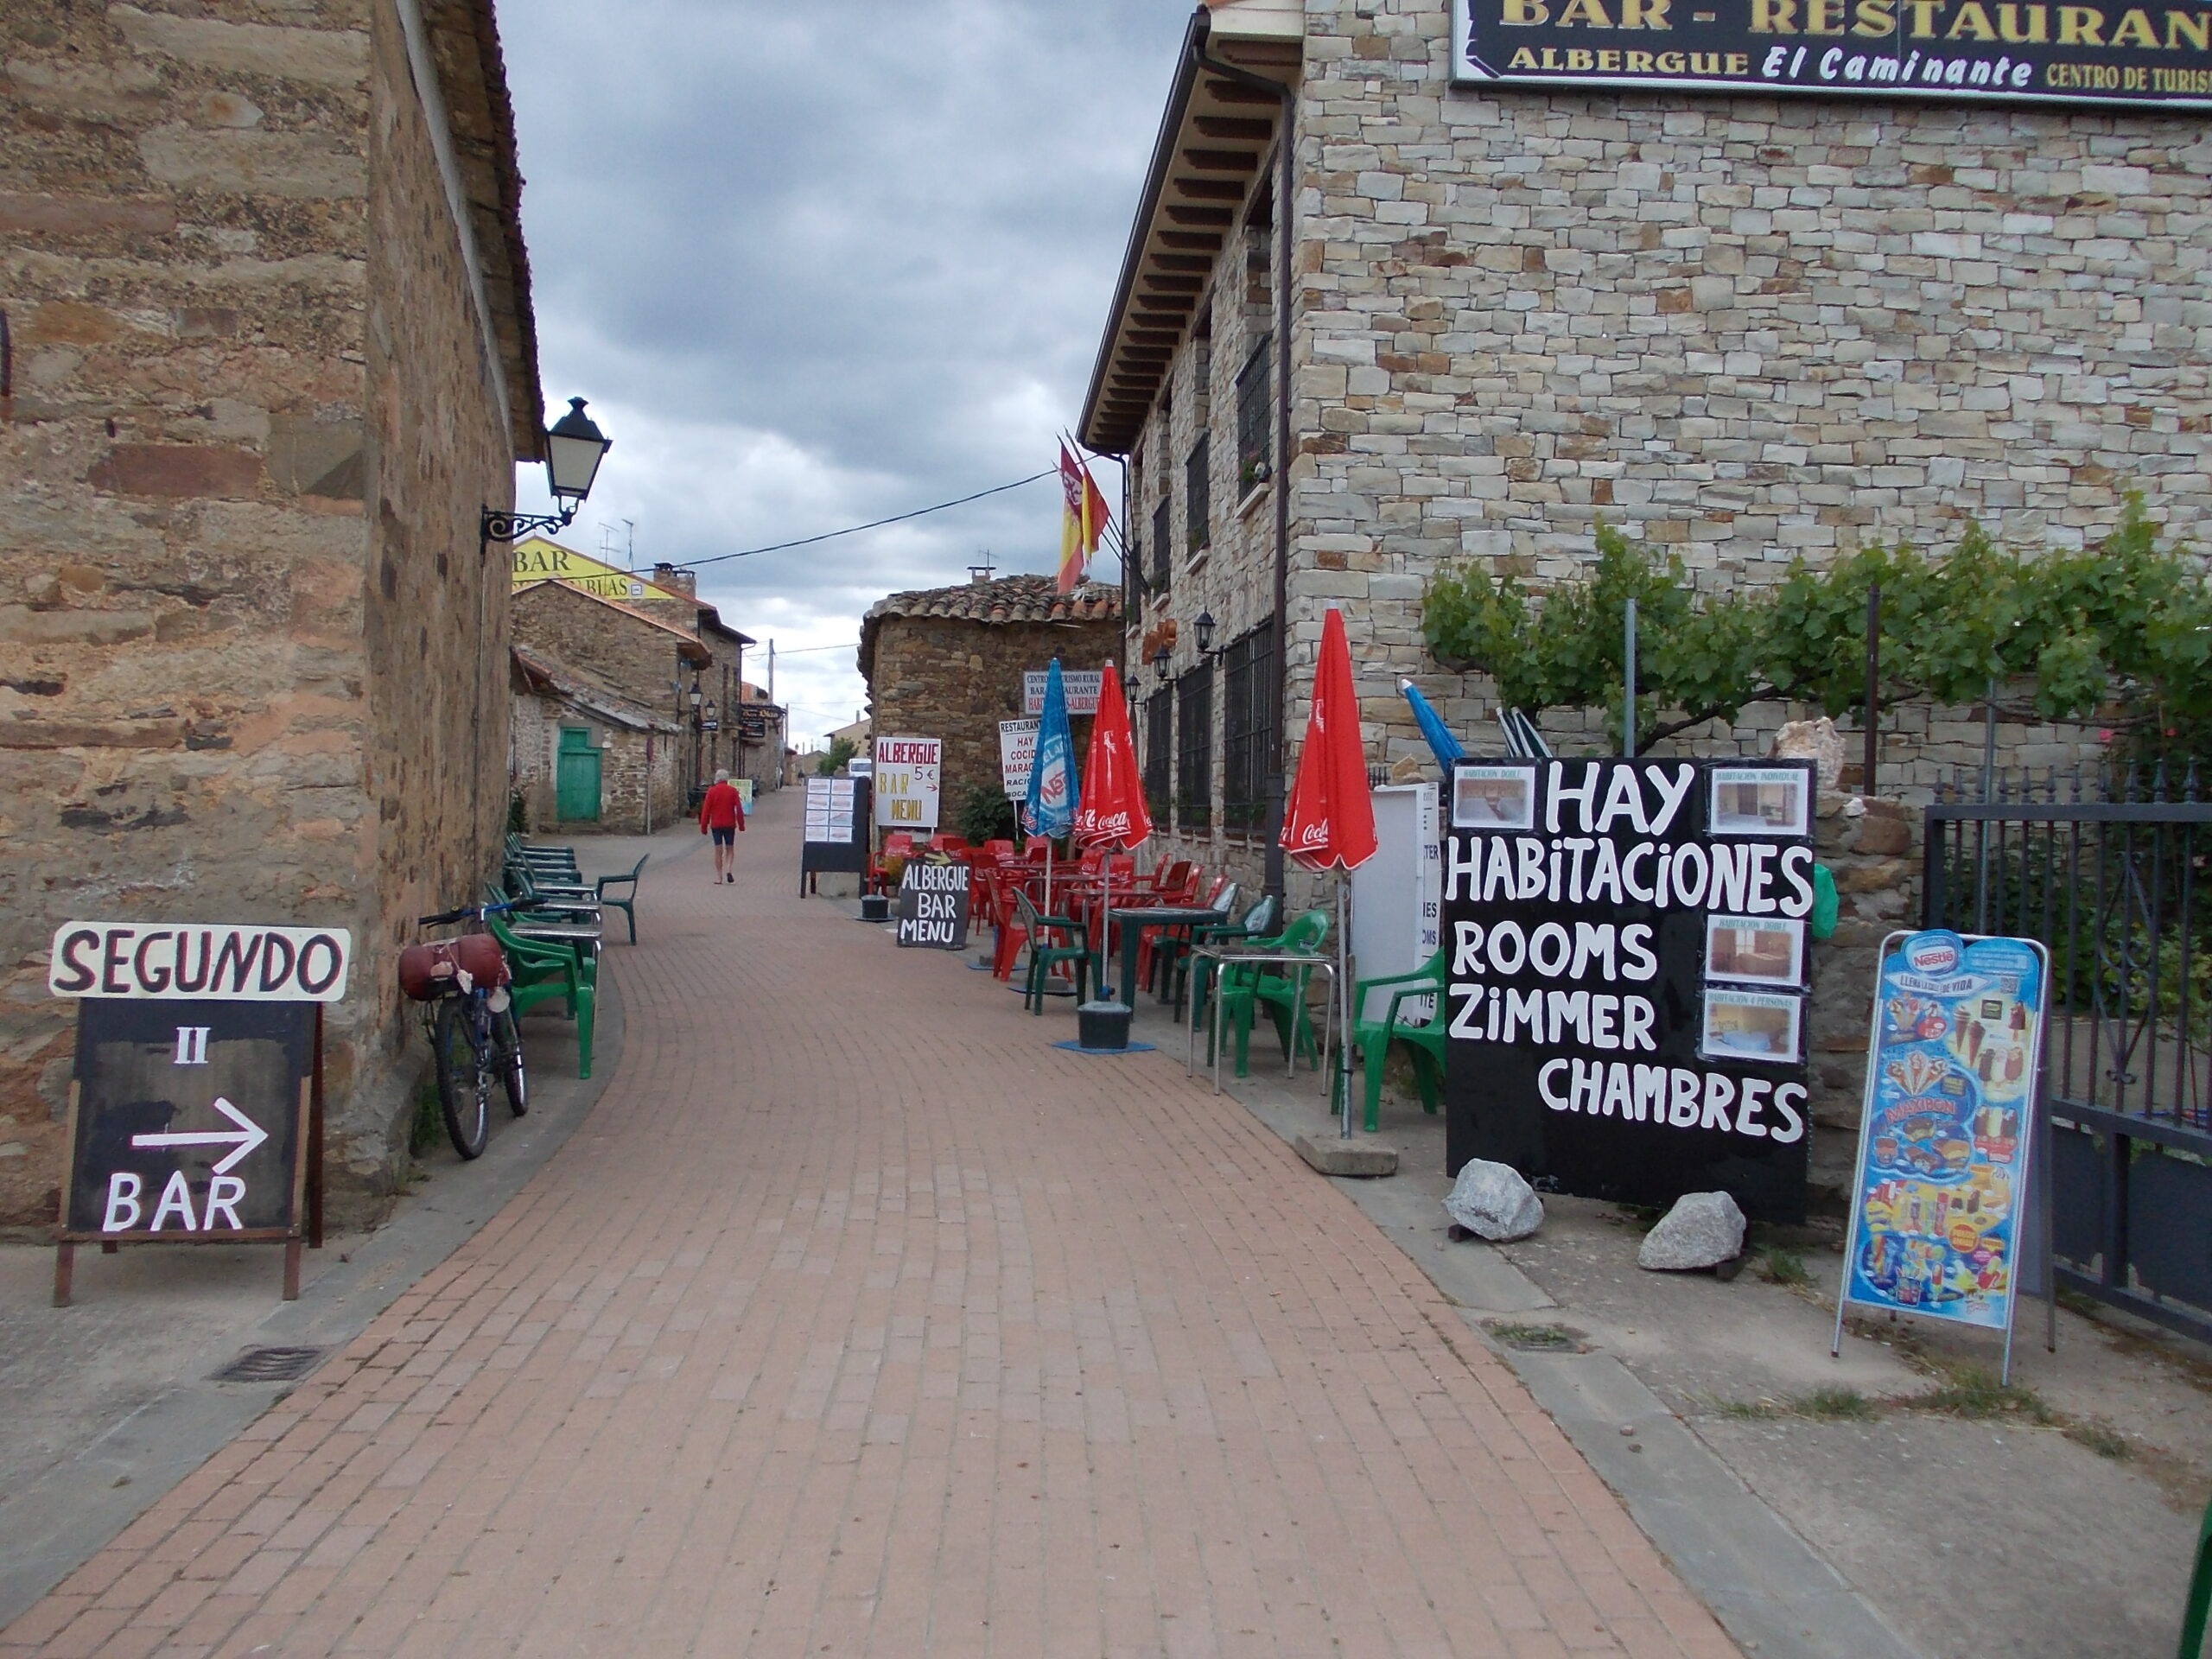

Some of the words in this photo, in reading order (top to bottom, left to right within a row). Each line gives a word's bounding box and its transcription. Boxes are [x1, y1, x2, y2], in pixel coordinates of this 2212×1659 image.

[1500, 0, 1673, 30] BAR
[1746, 0, 2212, 51] RESTAURAN
[1508, 47, 1748, 75] ALBERGUE
[1762, 46, 1808, 79] El
[1819, 47, 2032, 87] Caminante
[2046, 62, 2120, 88] CENTRO
[2123, 67, 2147, 91] DE
[513, 550, 572, 572] BAR
[878, 741, 939, 765] ALBERGUE
[1017, 736, 1034, 747] HAY
[1010, 749, 1037, 760] COCID
[914, 766, 924, 781] 5
[1005, 762, 1033, 773] MARAG
[879, 772, 909, 794] BAR
[891, 798, 923, 821] MENU
[1546, 760, 1695, 836] HAY
[901, 863, 969, 891] ALBERGUE
[918, 893, 957, 918] BAR
[900, 918, 955, 943] MENU
[54, 929, 343, 994] SEGUNDO
[1452, 919, 1658, 982] ROOMS
[1952, 978, 1973, 992] VIDA
[1538, 1058, 1808, 1144] CHAMBRES
[102, 1170, 246, 1232] BAR
